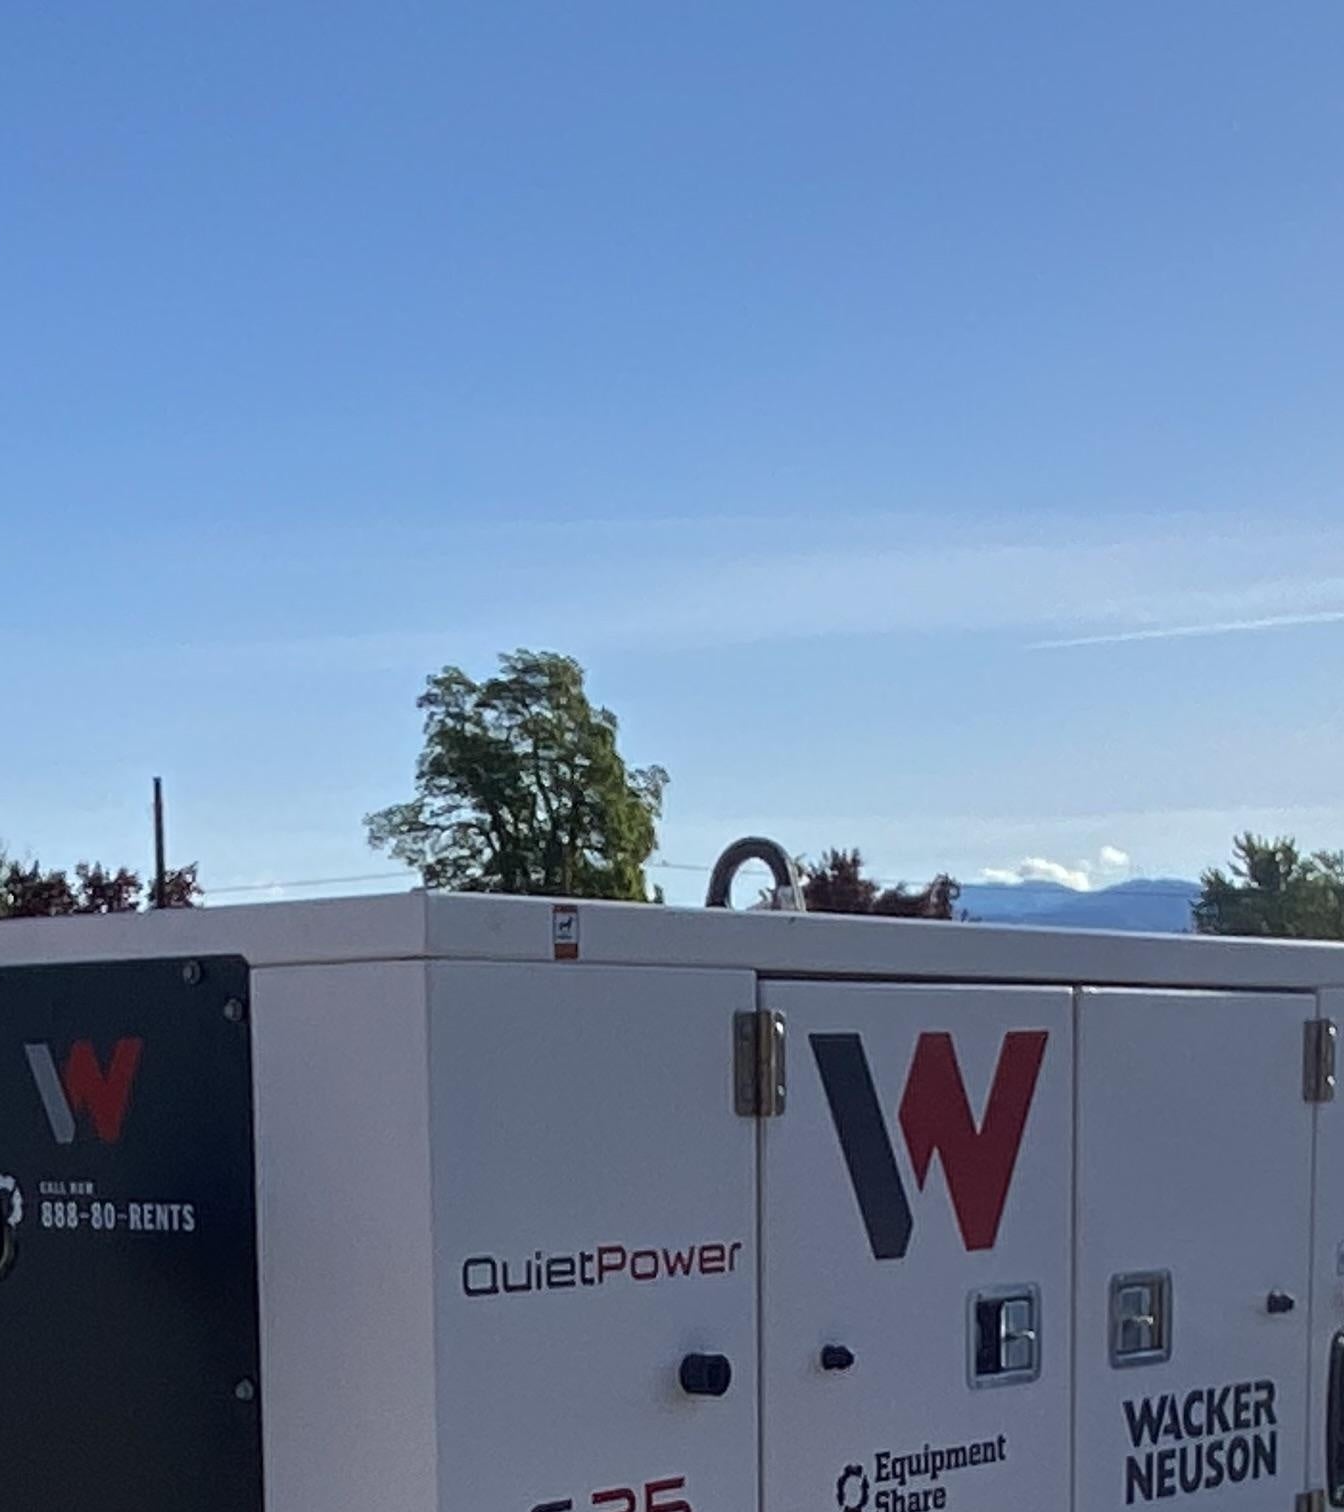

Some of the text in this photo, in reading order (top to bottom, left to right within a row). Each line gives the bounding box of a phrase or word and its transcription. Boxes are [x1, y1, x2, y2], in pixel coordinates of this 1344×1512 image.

[41, 1201, 196, 1232] 888-80-RENTS
[462, 1242, 743, 1297] QuietPower
[1122, 1380, 1278, 1449] WACKER
[874, 1434, 1007, 1487] Equipment
[1125, 1430, 1278, 1506] NEUSON
